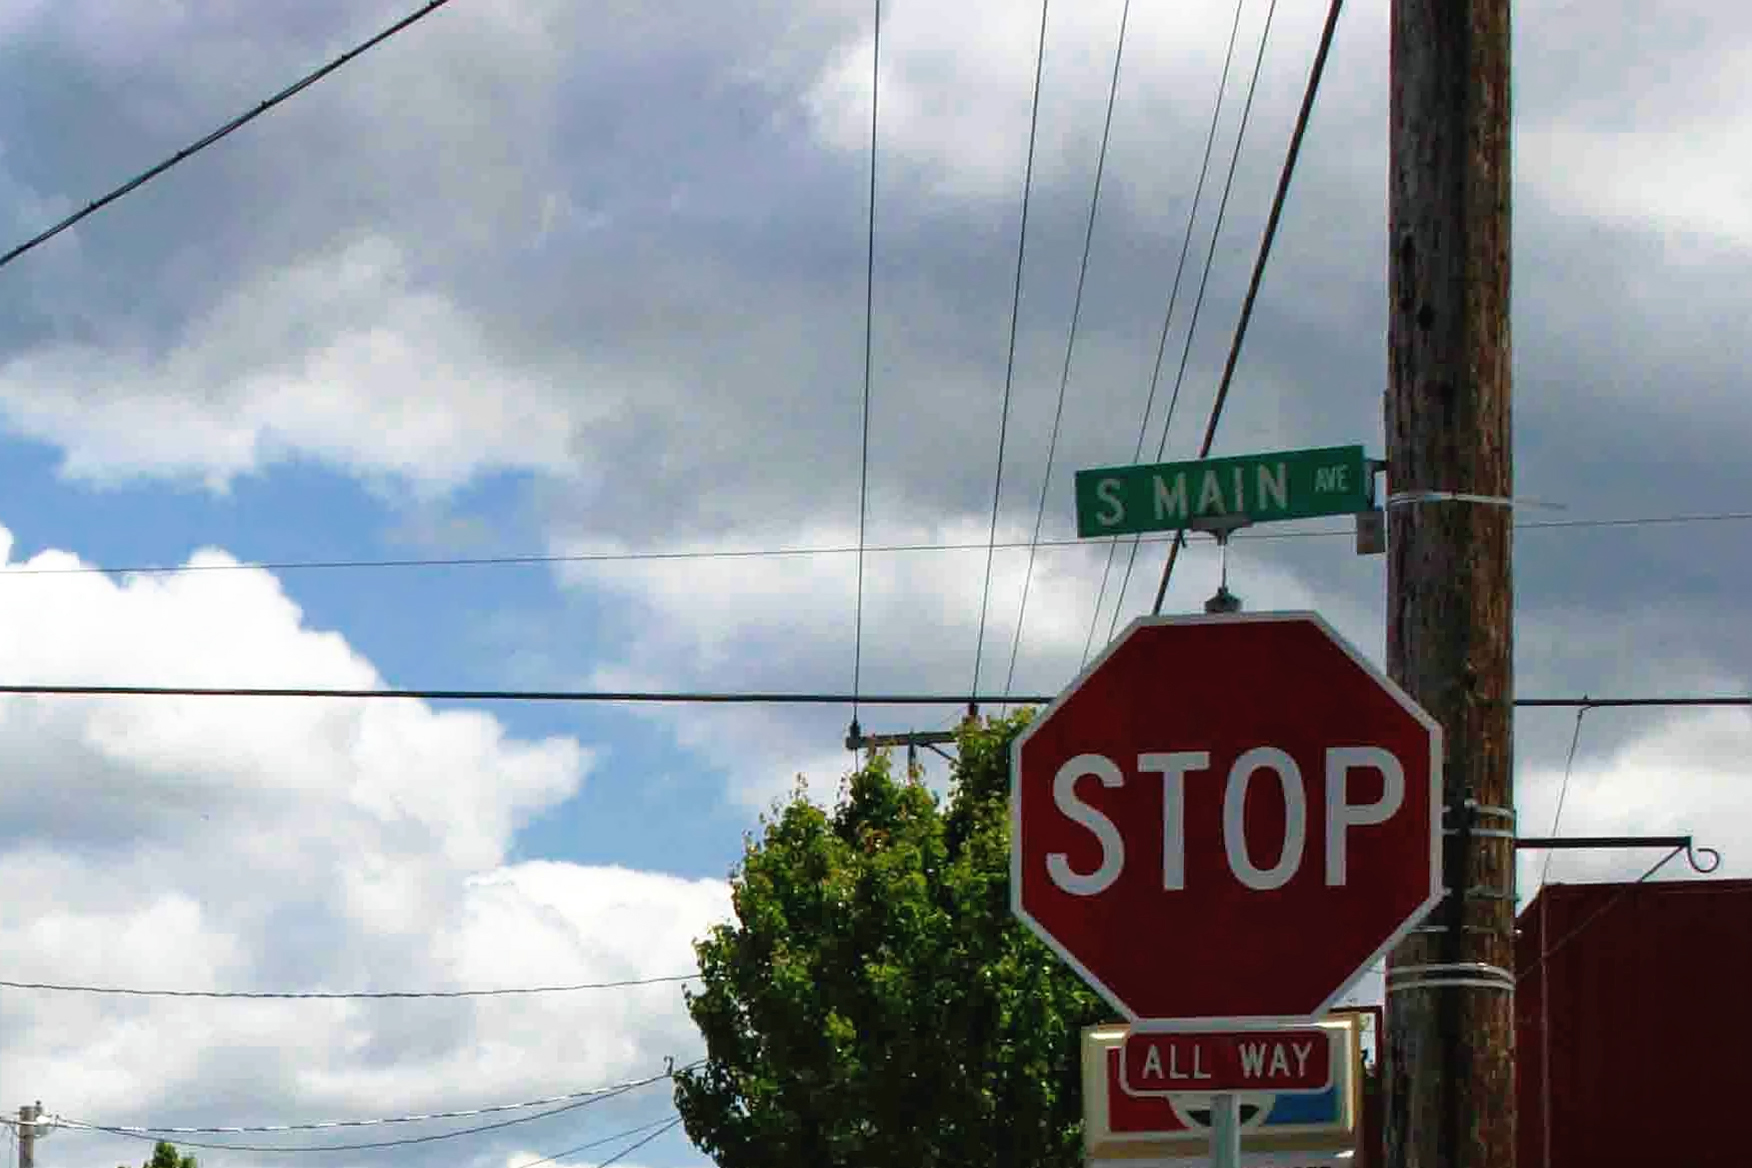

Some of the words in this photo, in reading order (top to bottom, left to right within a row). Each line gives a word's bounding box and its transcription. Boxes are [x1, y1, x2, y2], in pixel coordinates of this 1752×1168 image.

[1096, 478, 1127, 526] S
[1152, 463, 1288, 520] MAIN
[1314, 464, 1349, 493] AVE
[1045, 746, 1406, 895] STOP
[1142, 1044, 1212, 1079] ALL
[1238, 1042, 1313, 1079] WAY
